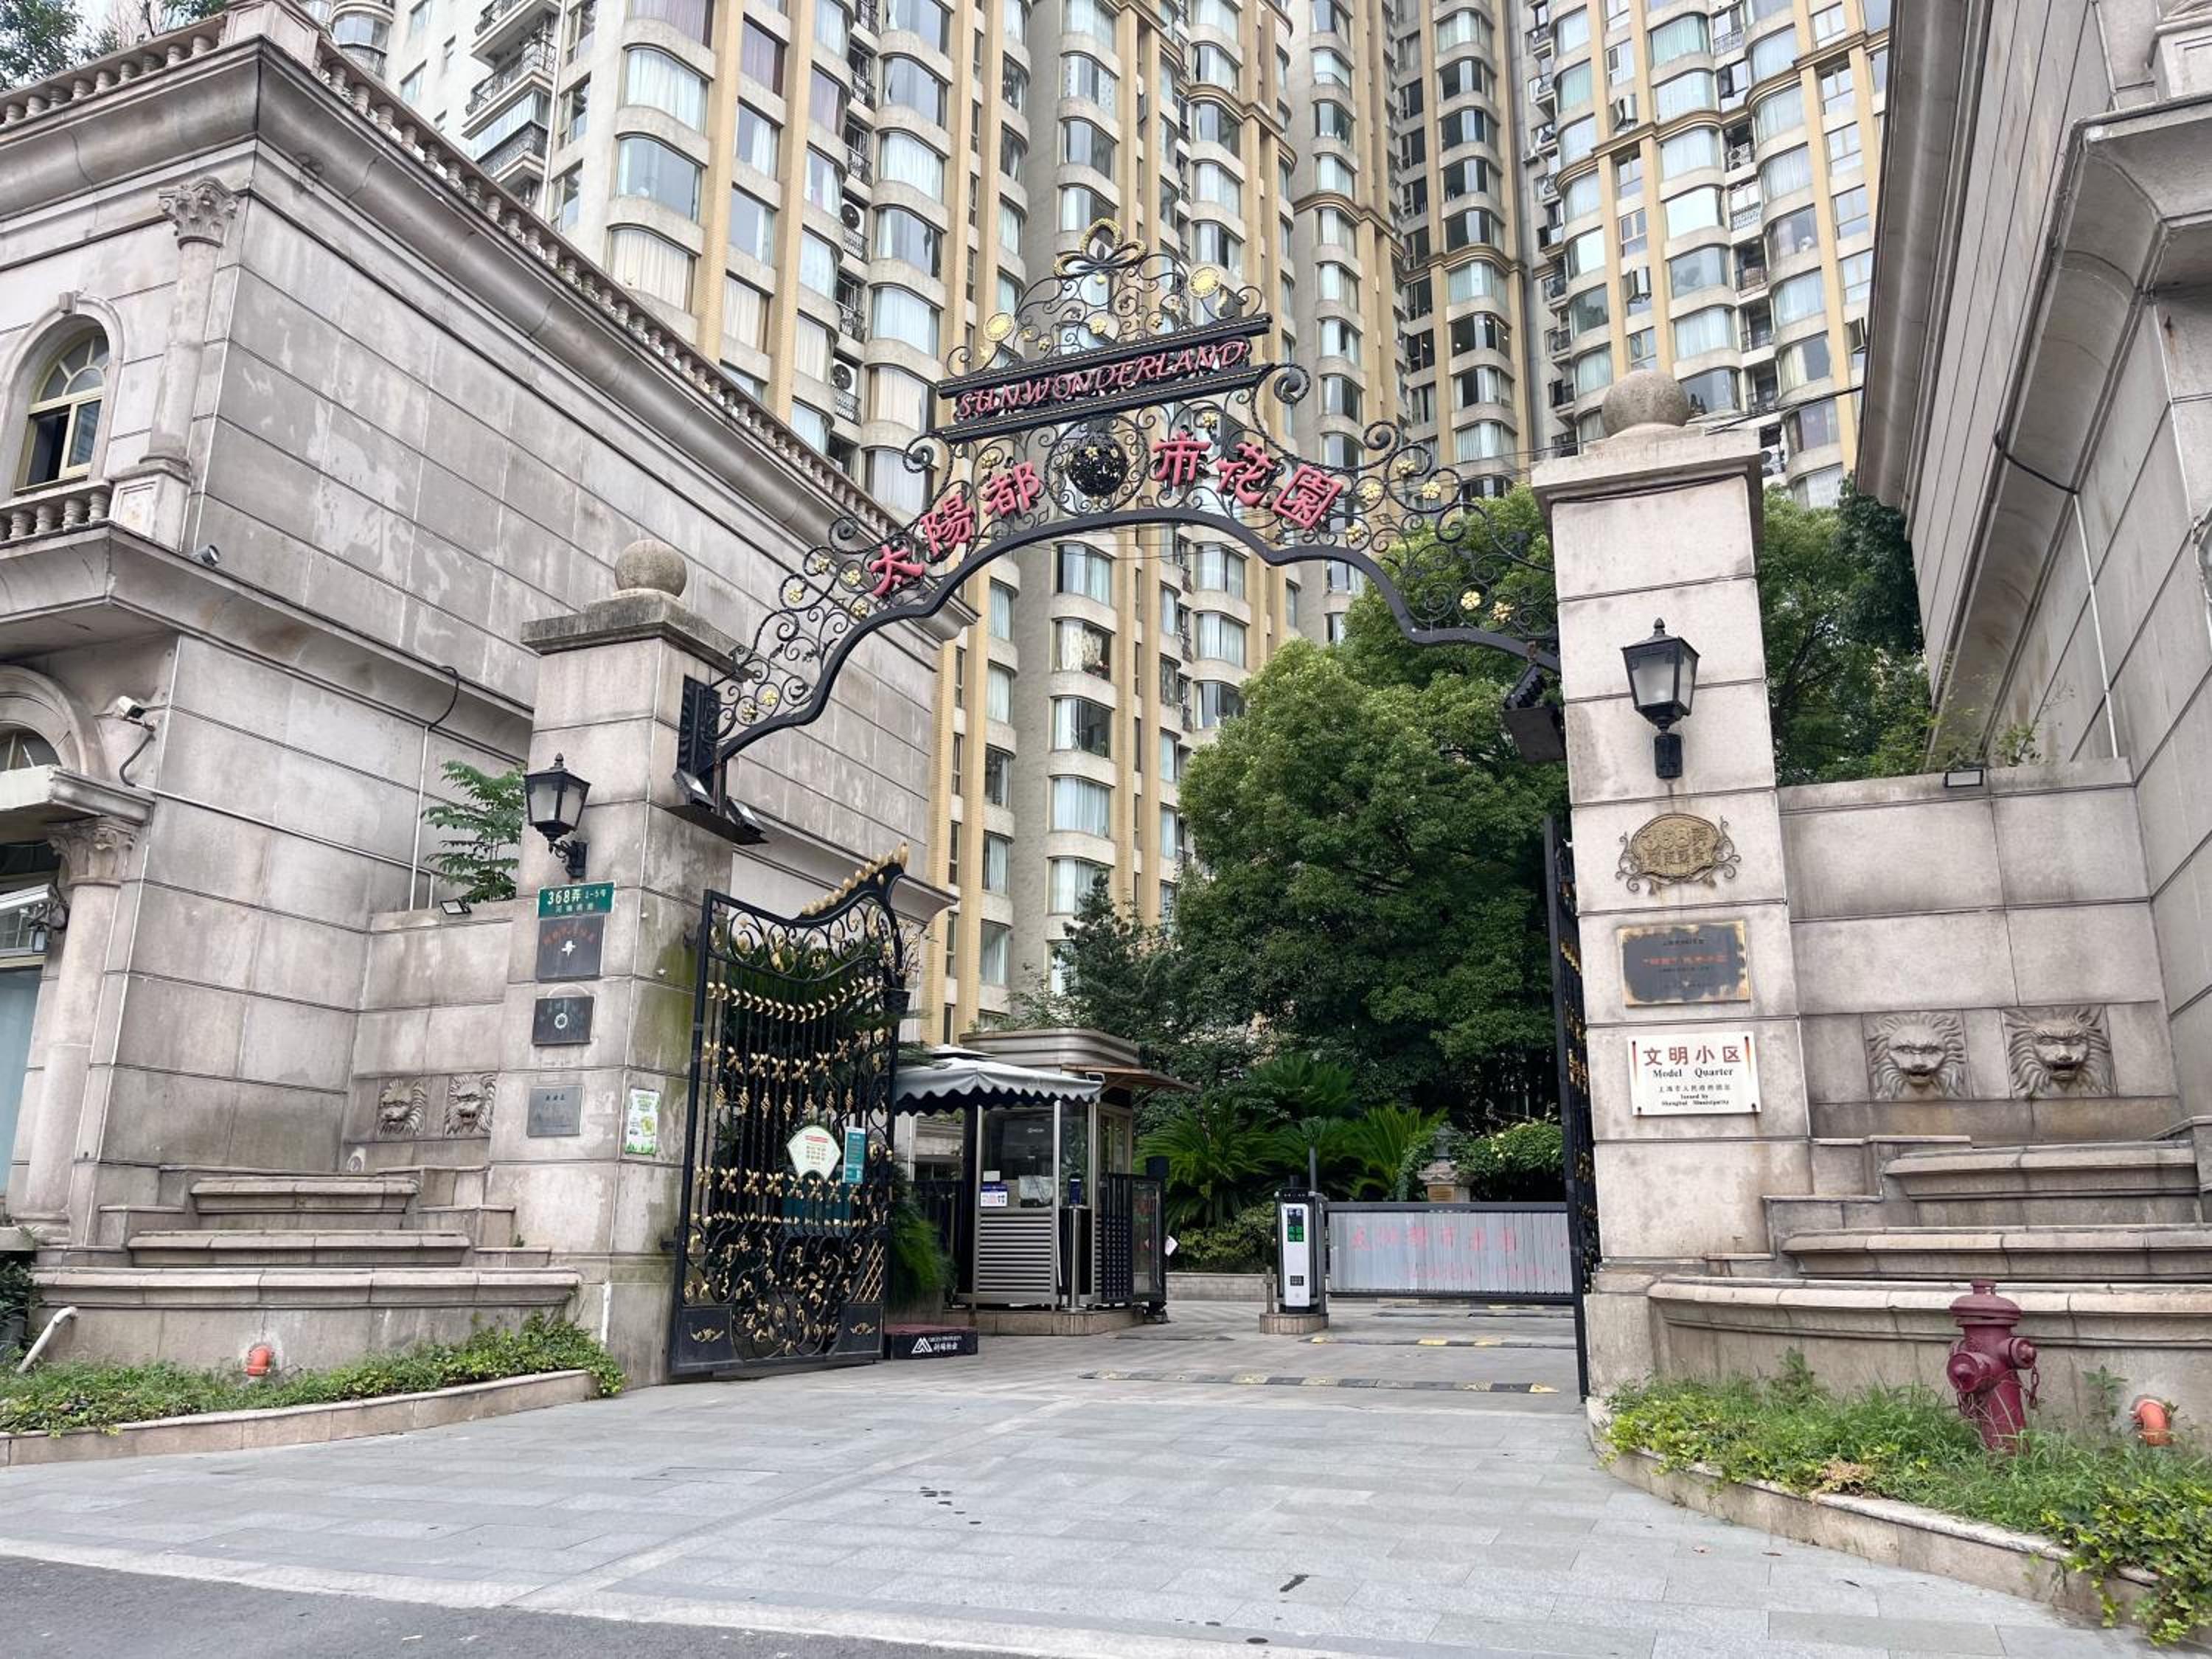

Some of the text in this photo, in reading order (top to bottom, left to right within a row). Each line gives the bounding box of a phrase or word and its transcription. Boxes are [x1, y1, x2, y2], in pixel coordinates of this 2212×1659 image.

[547, 888, 582, 905] 368弄
[1643, 1045, 1741, 1066] 文明小区
[1653, 1068, 1733, 1078] Model Quarter
